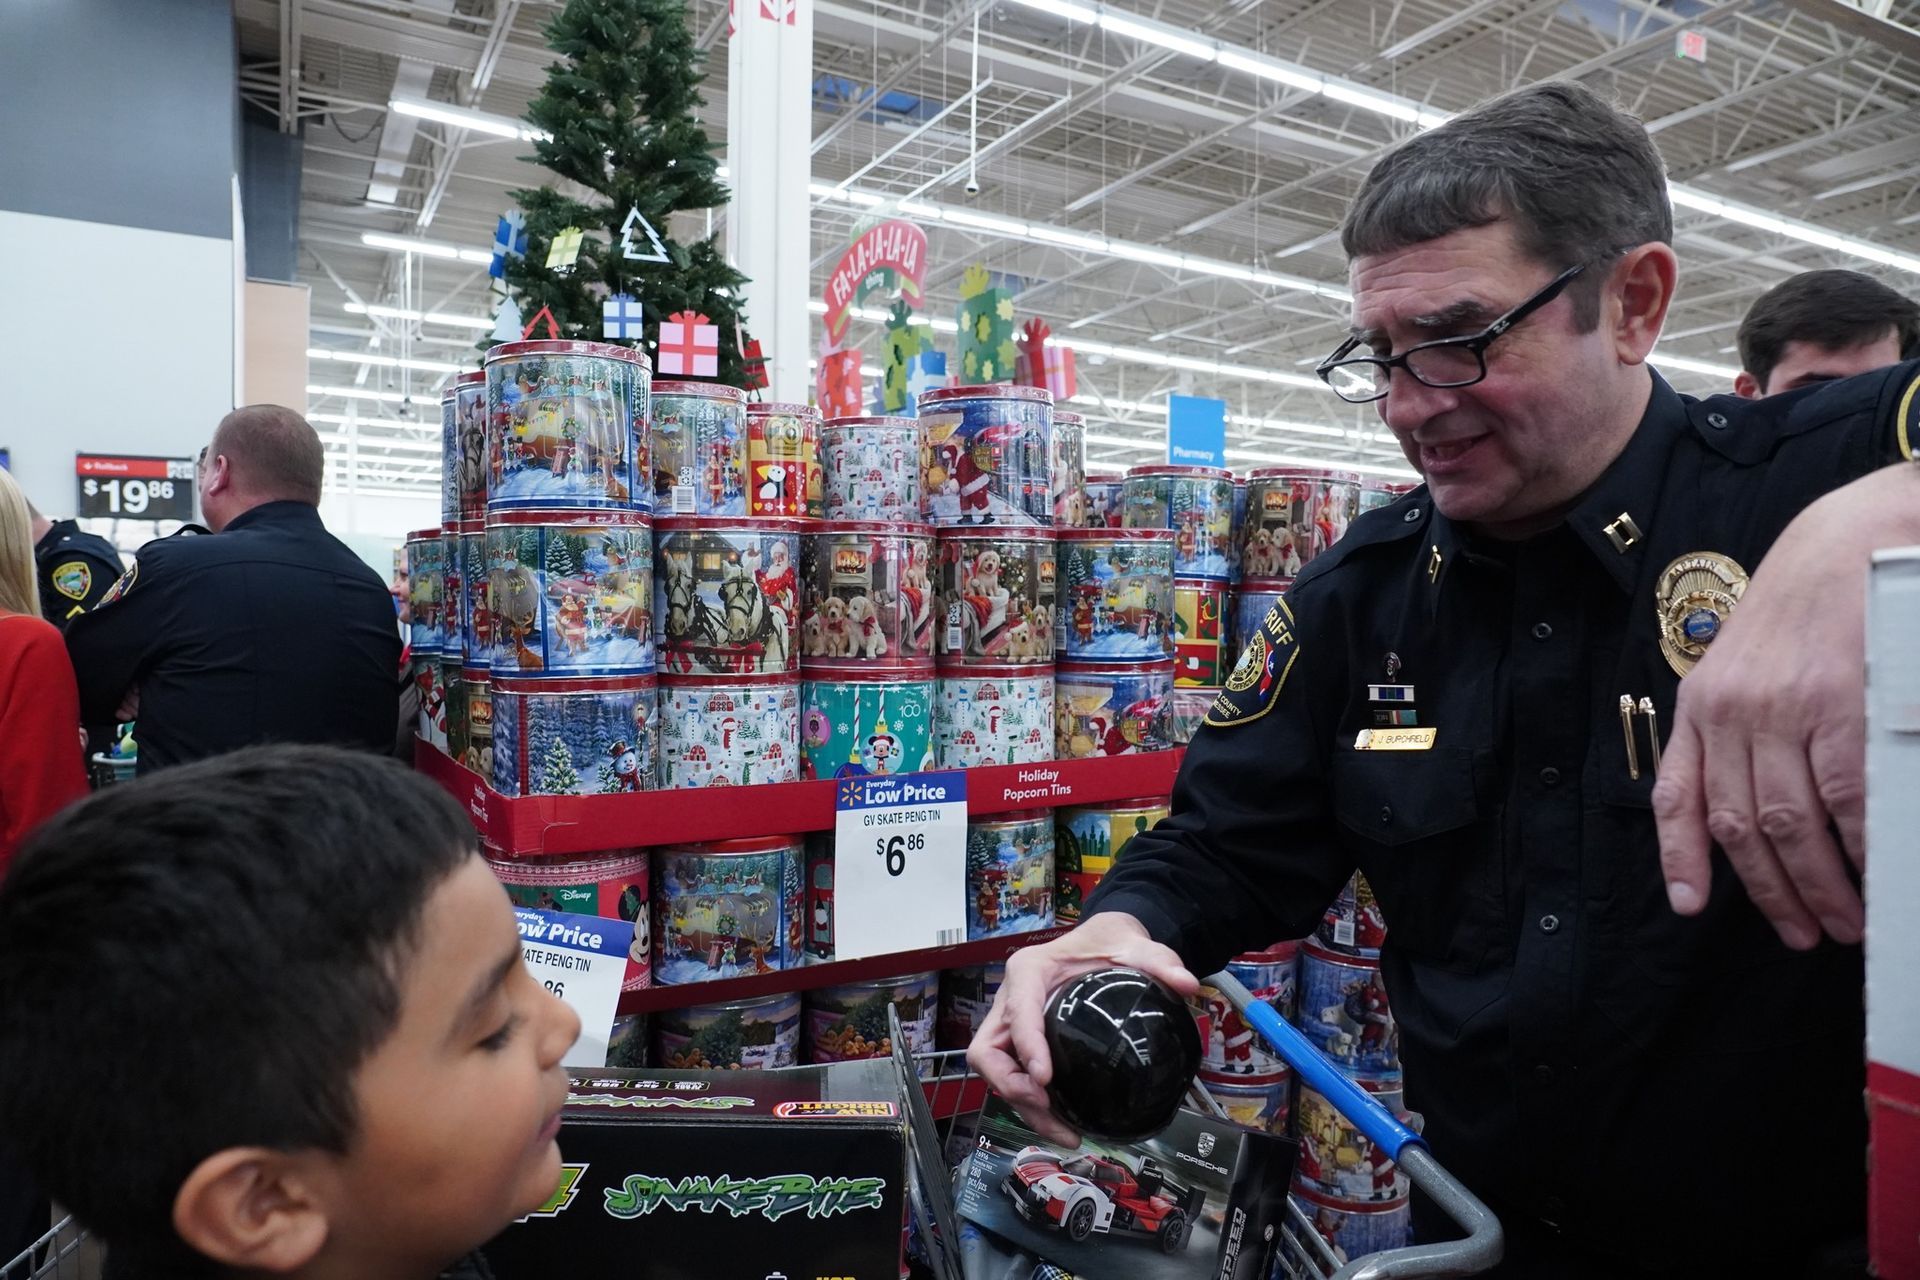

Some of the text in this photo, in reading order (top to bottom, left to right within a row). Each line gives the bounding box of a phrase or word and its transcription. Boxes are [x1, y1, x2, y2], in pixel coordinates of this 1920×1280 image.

[1173, 446, 1215, 462] Pharmacy
[1264, 606, 1294, 646] RIFF
[899, 704, 921, 718] 100
[1220, 695, 1242, 716] COUNTY
[866, 780, 896, 789] Everyday
[1018, 768, 1059, 783] Holiday
[865, 783, 946, 805] Low Price
[1003, 784, 1072, 802] Popcorn Tins
[863, 809, 941, 827] GV SKATE PENG TIN
[560, 889, 592, 902] Disney
[517, 922, 603, 949] ow Price
[545, 952, 574, 969] PENG
[576, 957, 592, 972] TIN
[836, 1108, 888, 1116] NEW
[978, 1134, 992, 1149] 9+
[1176, 1151, 1229, 1175] PORSCHE
